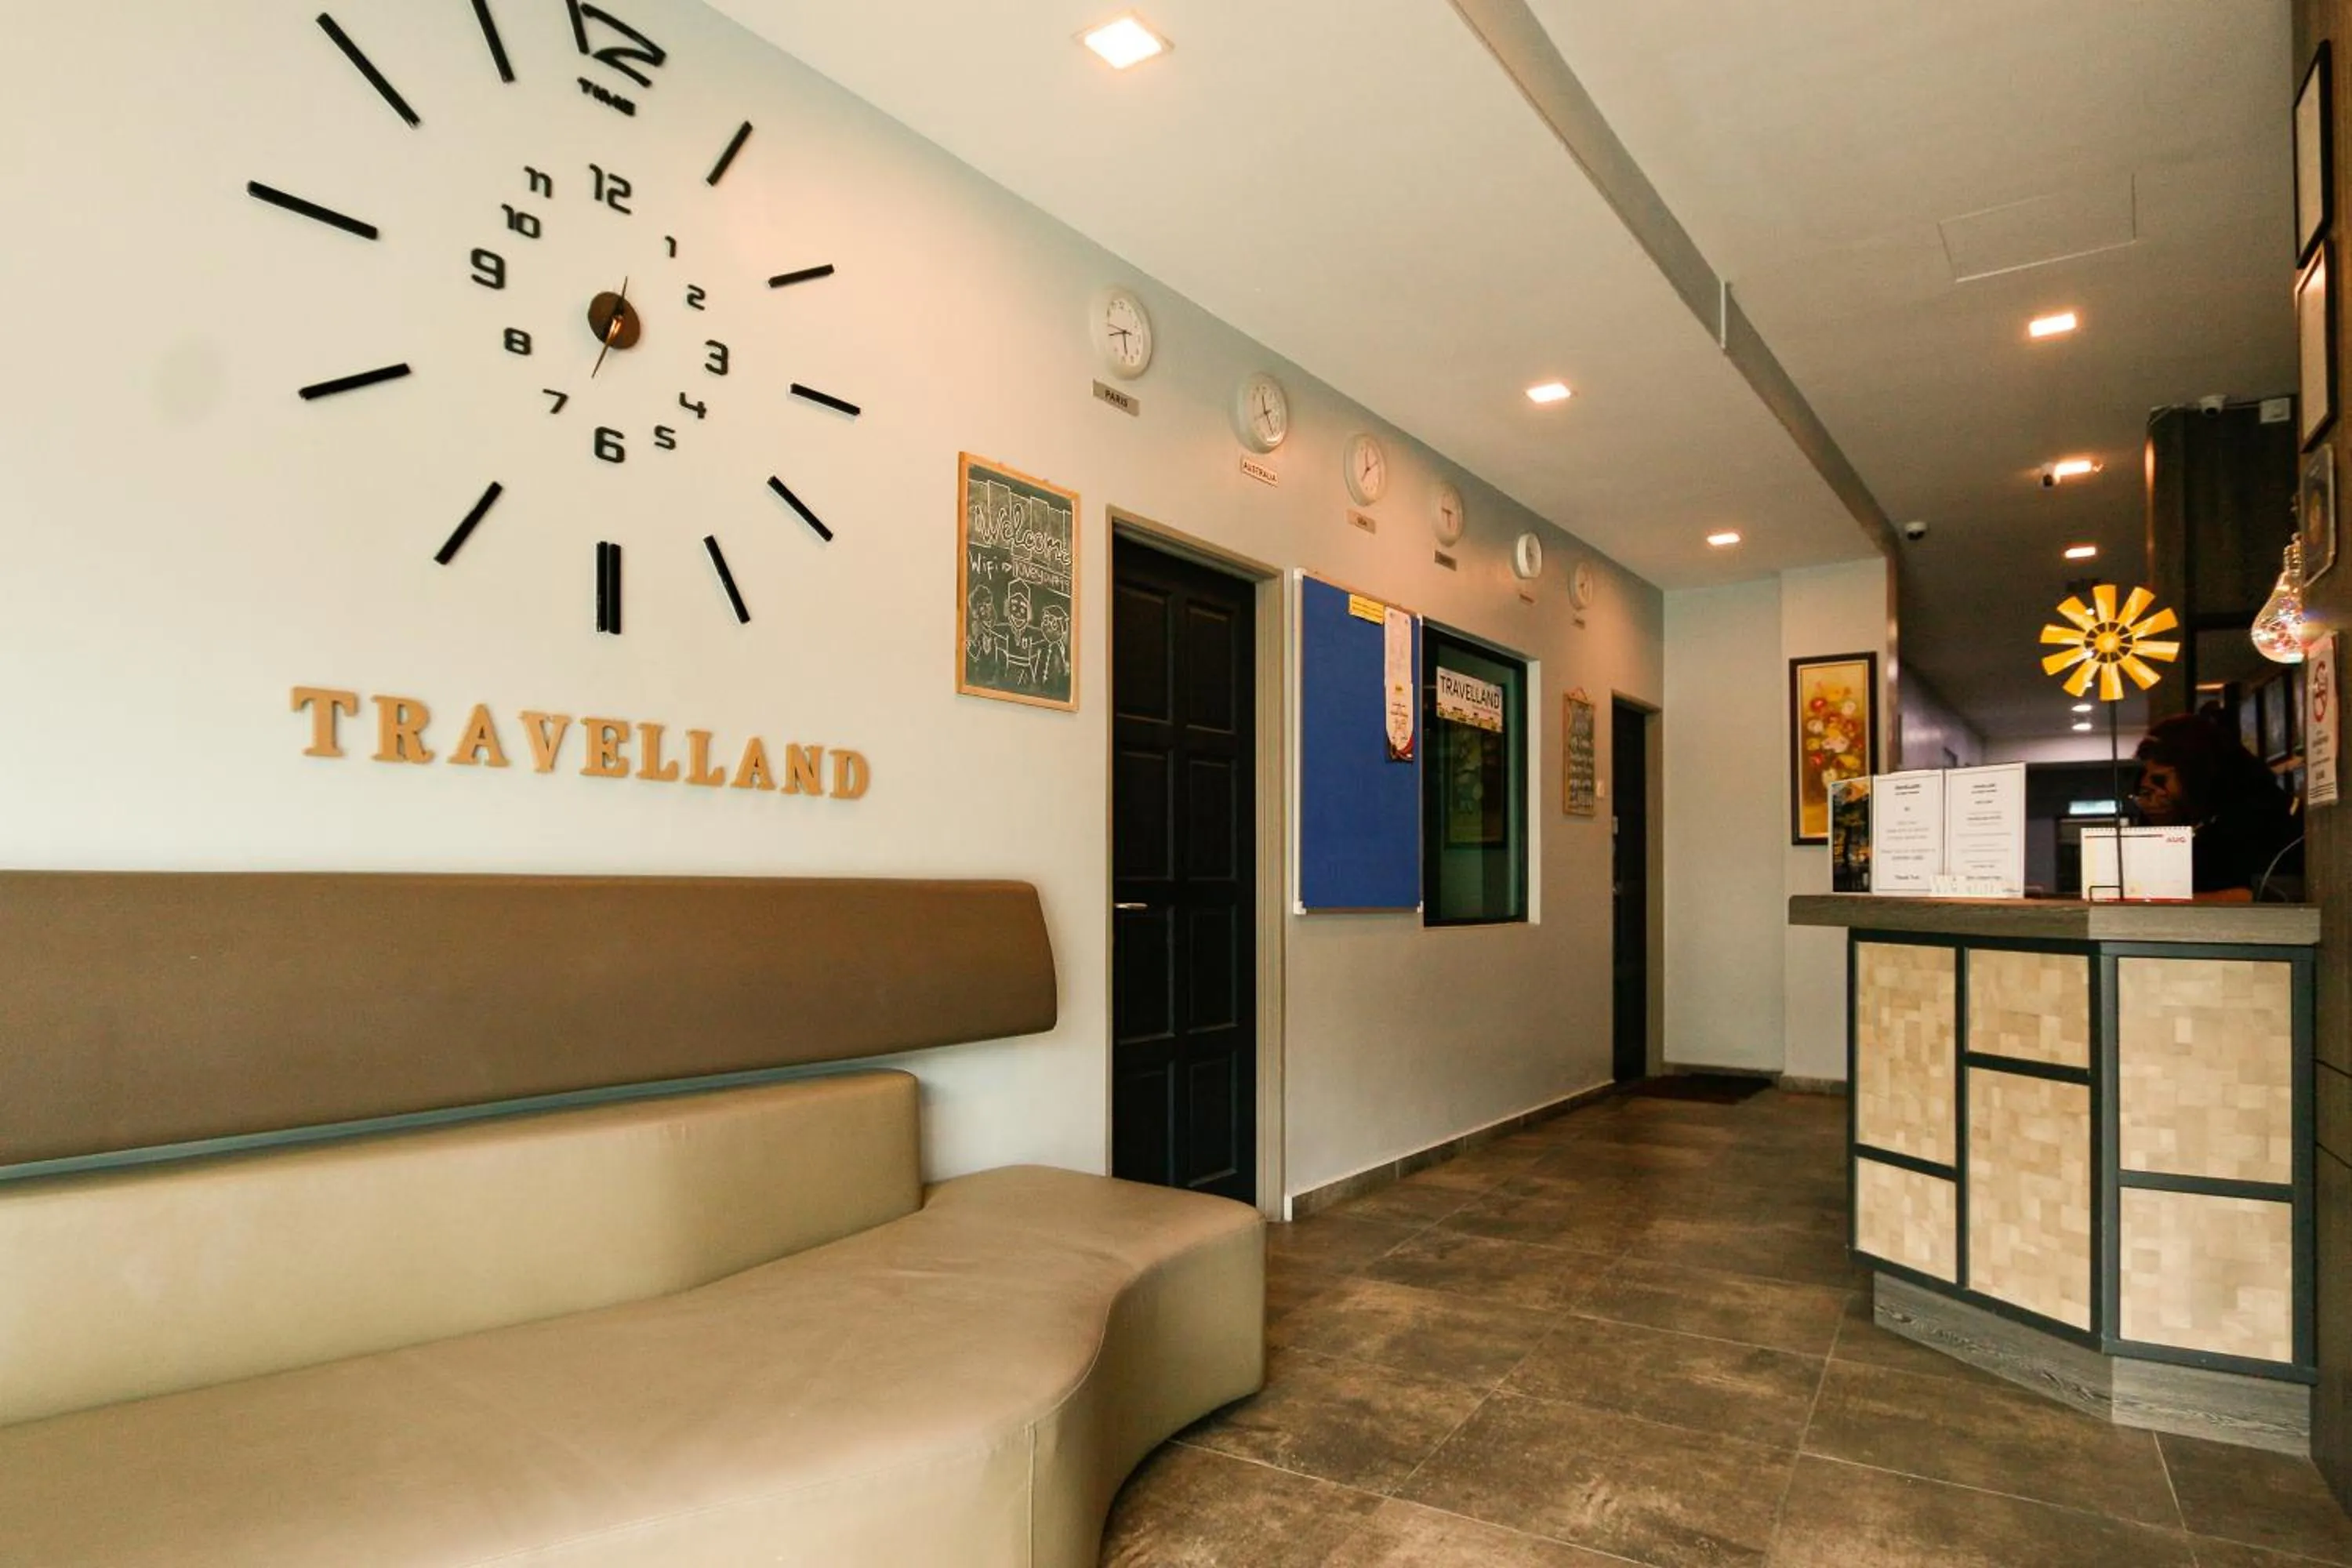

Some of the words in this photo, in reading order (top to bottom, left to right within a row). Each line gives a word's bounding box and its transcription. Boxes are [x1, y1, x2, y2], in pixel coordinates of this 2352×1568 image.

[590, 164, 631, 215] 12
[502, 204, 540, 238] 10
[665, 236, 676, 257] 1
[471, 249, 505, 289] 9
[687, 285, 706, 310] 2
[504, 328, 532, 355] 8
[705, 340, 728, 376] 3
[543, 389, 568, 414] 7
[680, 392, 706, 419] 4
[1105, 390, 1128, 408] PARIS
[594, 426, 625, 463] 6
[655, 426, 676, 450] 5
[1243, 461, 1276, 481] AUSTRALIA
[1440, 675, 1500, 709] TRAVELLAND
[290, 687, 870, 800] TRAVELLAND
